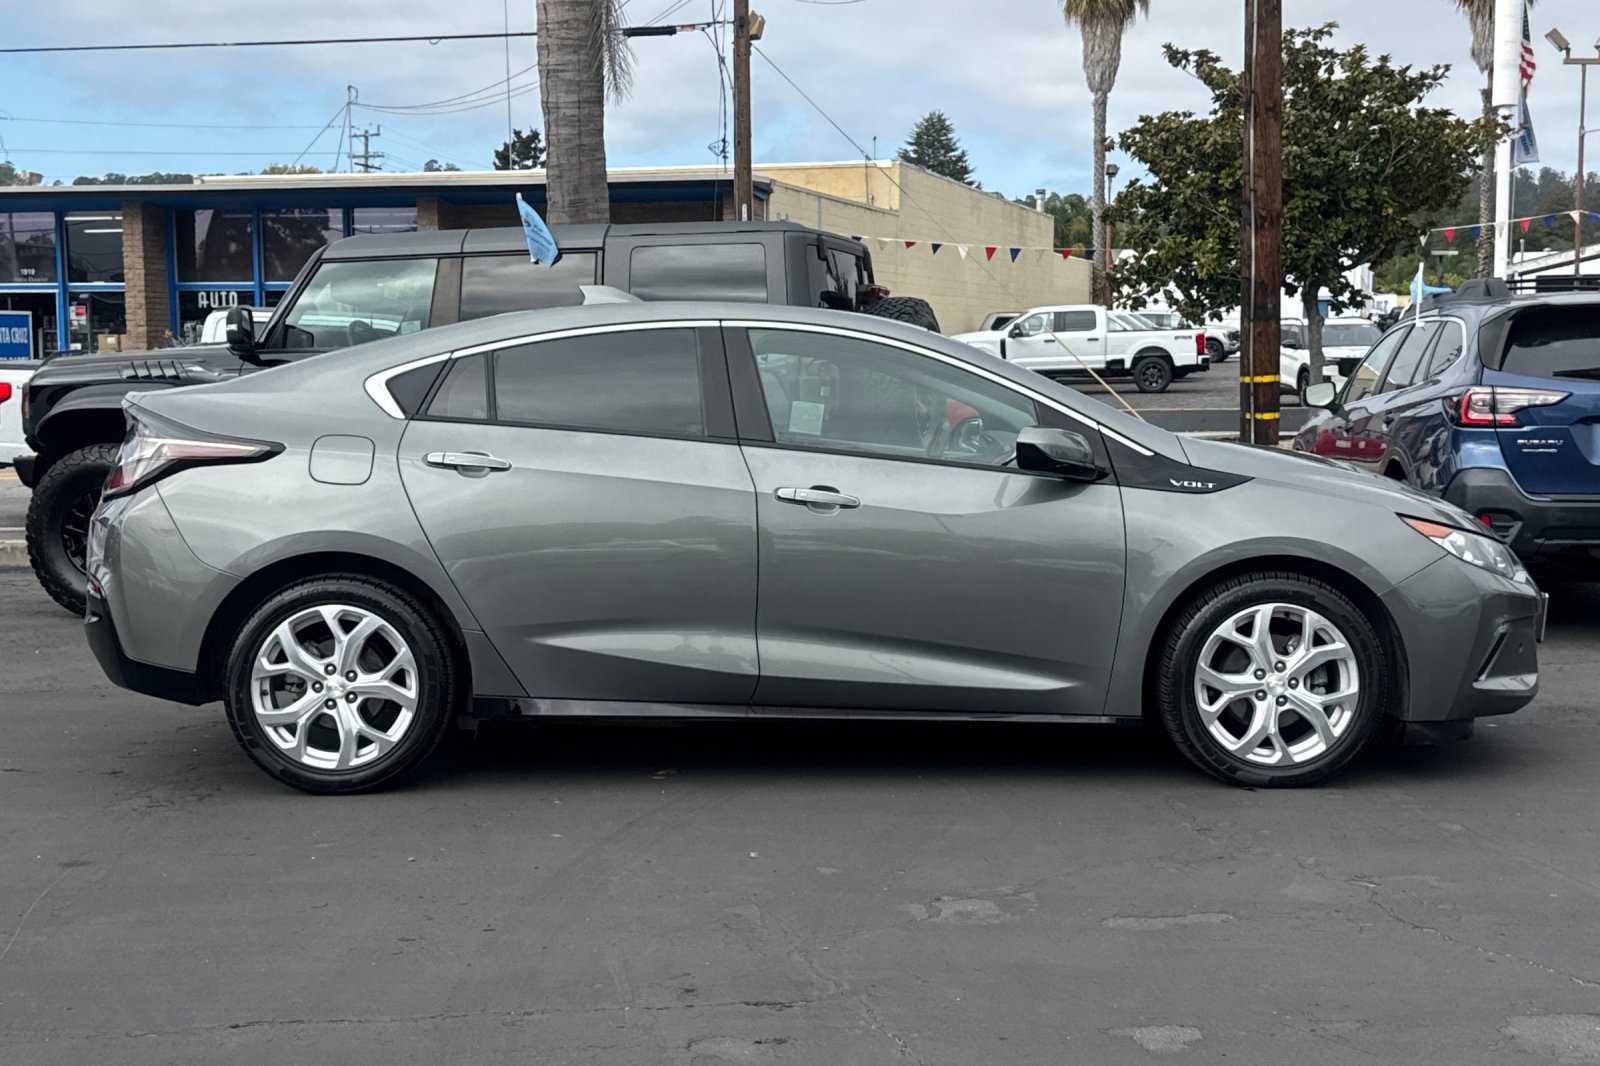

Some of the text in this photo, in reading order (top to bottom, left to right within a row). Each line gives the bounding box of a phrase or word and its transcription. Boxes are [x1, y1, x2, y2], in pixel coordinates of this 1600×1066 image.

[198, 291, 238, 309] AUTO
[11, 327, 28, 344] CRUZ
[1169, 478, 1217, 489] VOLT
